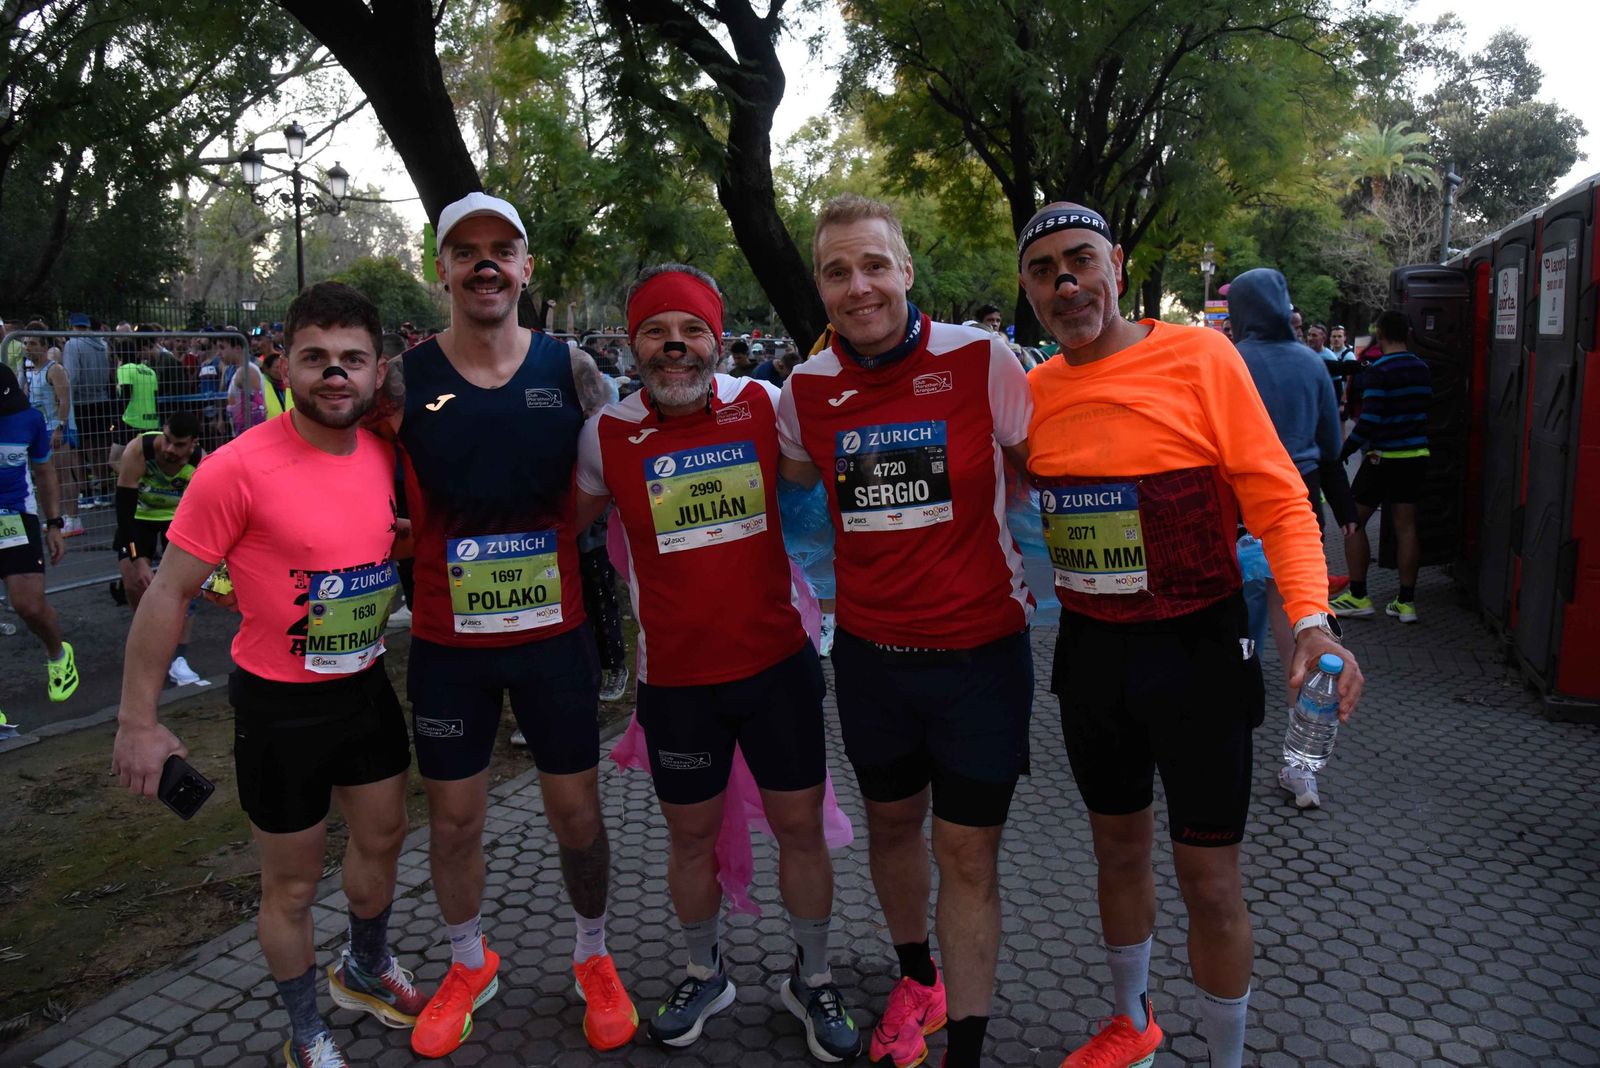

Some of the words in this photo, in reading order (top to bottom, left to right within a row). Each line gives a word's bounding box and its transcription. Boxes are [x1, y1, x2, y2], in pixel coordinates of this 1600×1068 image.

[869, 428, 932, 446] ZURICH
[683, 448, 744, 468] ZURICH
[873, 461, 906, 477] 4720
[689, 480, 722, 497] 2990
[854, 480, 929, 507] SERGIO
[1062, 491, 1122, 508] ZURICH
[675, 494, 746, 526] JULIÁN
[1067, 526, 1096, 540] 2071
[487, 537, 545, 554] ZURICH
[1049, 546, 1098, 569] LERMA
[1103, 546, 1144, 569] MM
[491, 569, 523, 583] 1697
[468, 585, 547, 611] POLAKO
[352, 603, 377, 621] 1630
